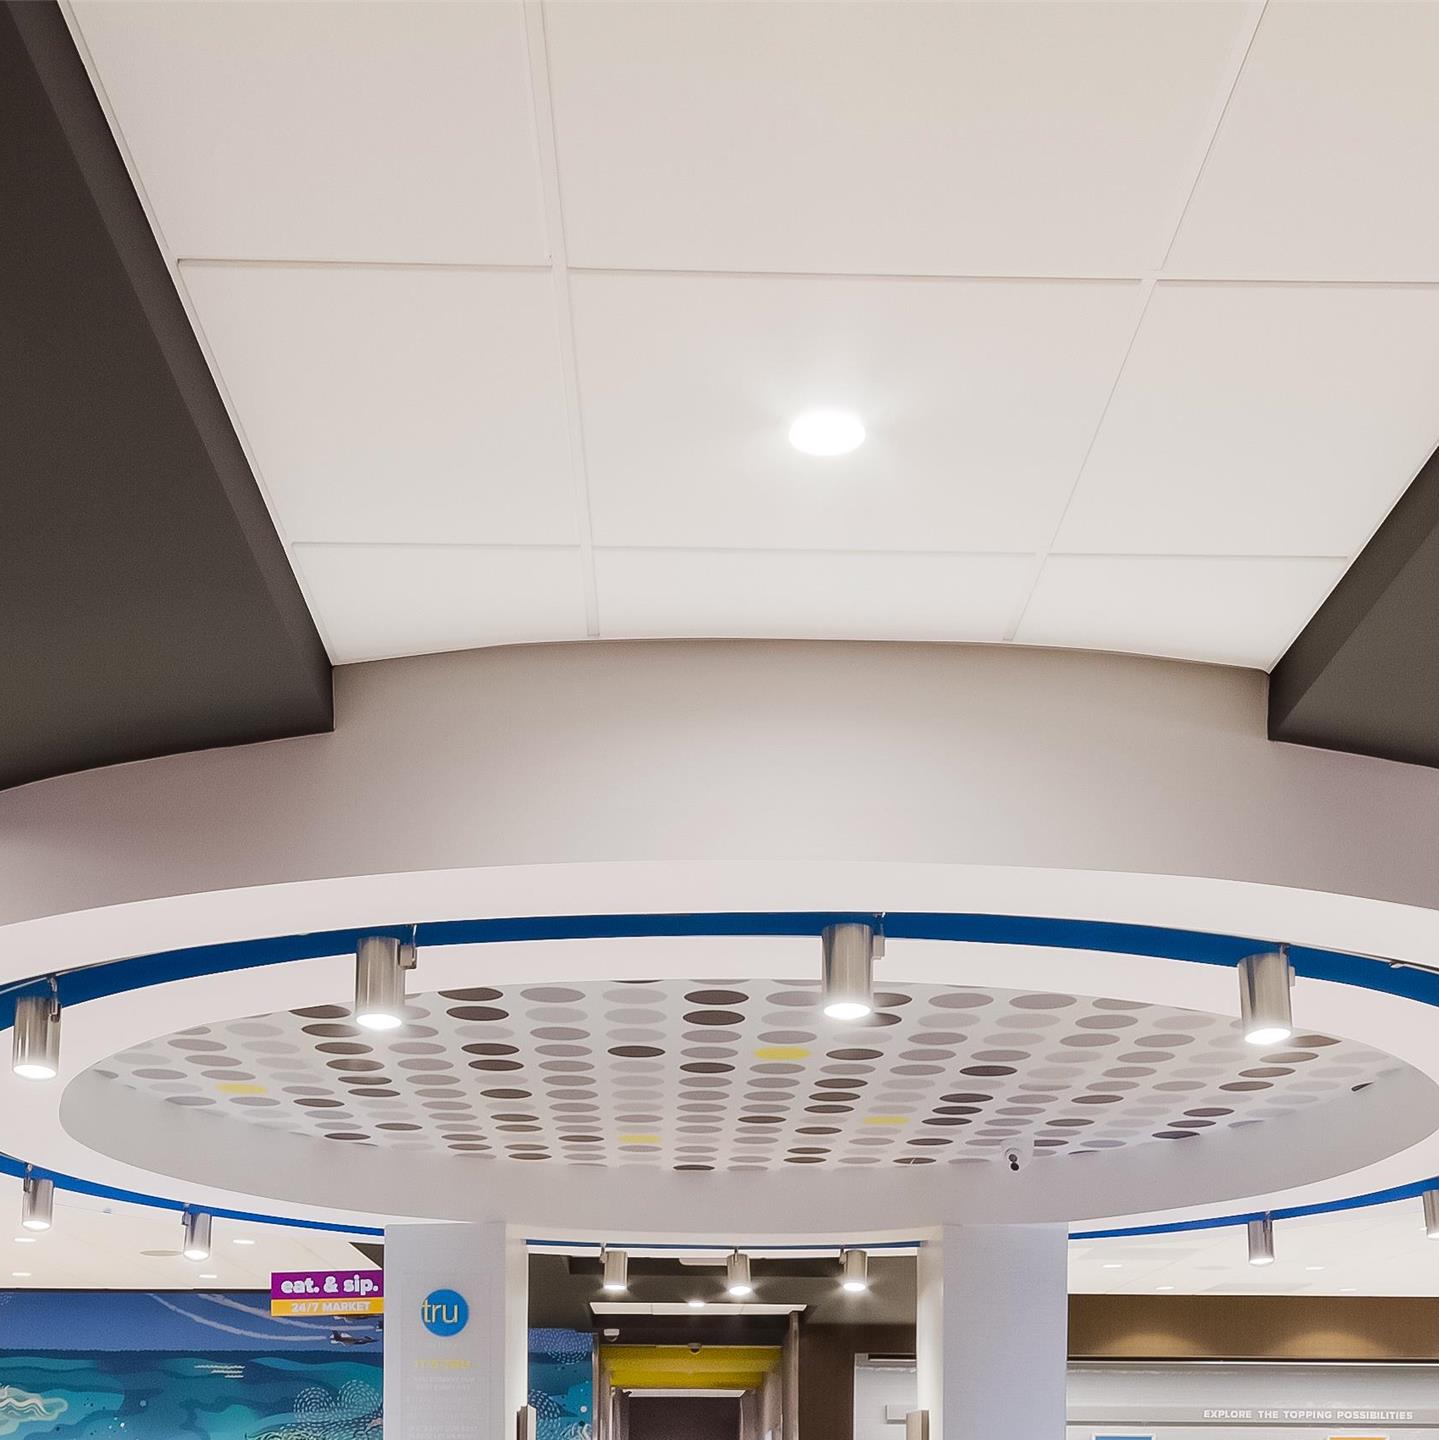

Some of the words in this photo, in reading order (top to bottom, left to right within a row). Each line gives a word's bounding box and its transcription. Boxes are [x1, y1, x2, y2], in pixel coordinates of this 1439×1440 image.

[280, 1277, 320, 1294] eat.
[323, 1275, 339, 1293] &
[343, 1273, 379, 1296] sip.
[291, 1302, 319, 1313] 24/7
[322, 1301, 371, 1312] MARKET
[421, 1299, 459, 1324] tru
[1203, 1409, 1252, 1419] EXPLORE
[1258, 1410, 1279, 1419] THE
[1283, 1410, 1332, 1420] TOPPING
[1337, 1410, 1414, 1420] POSSIBILITIES
